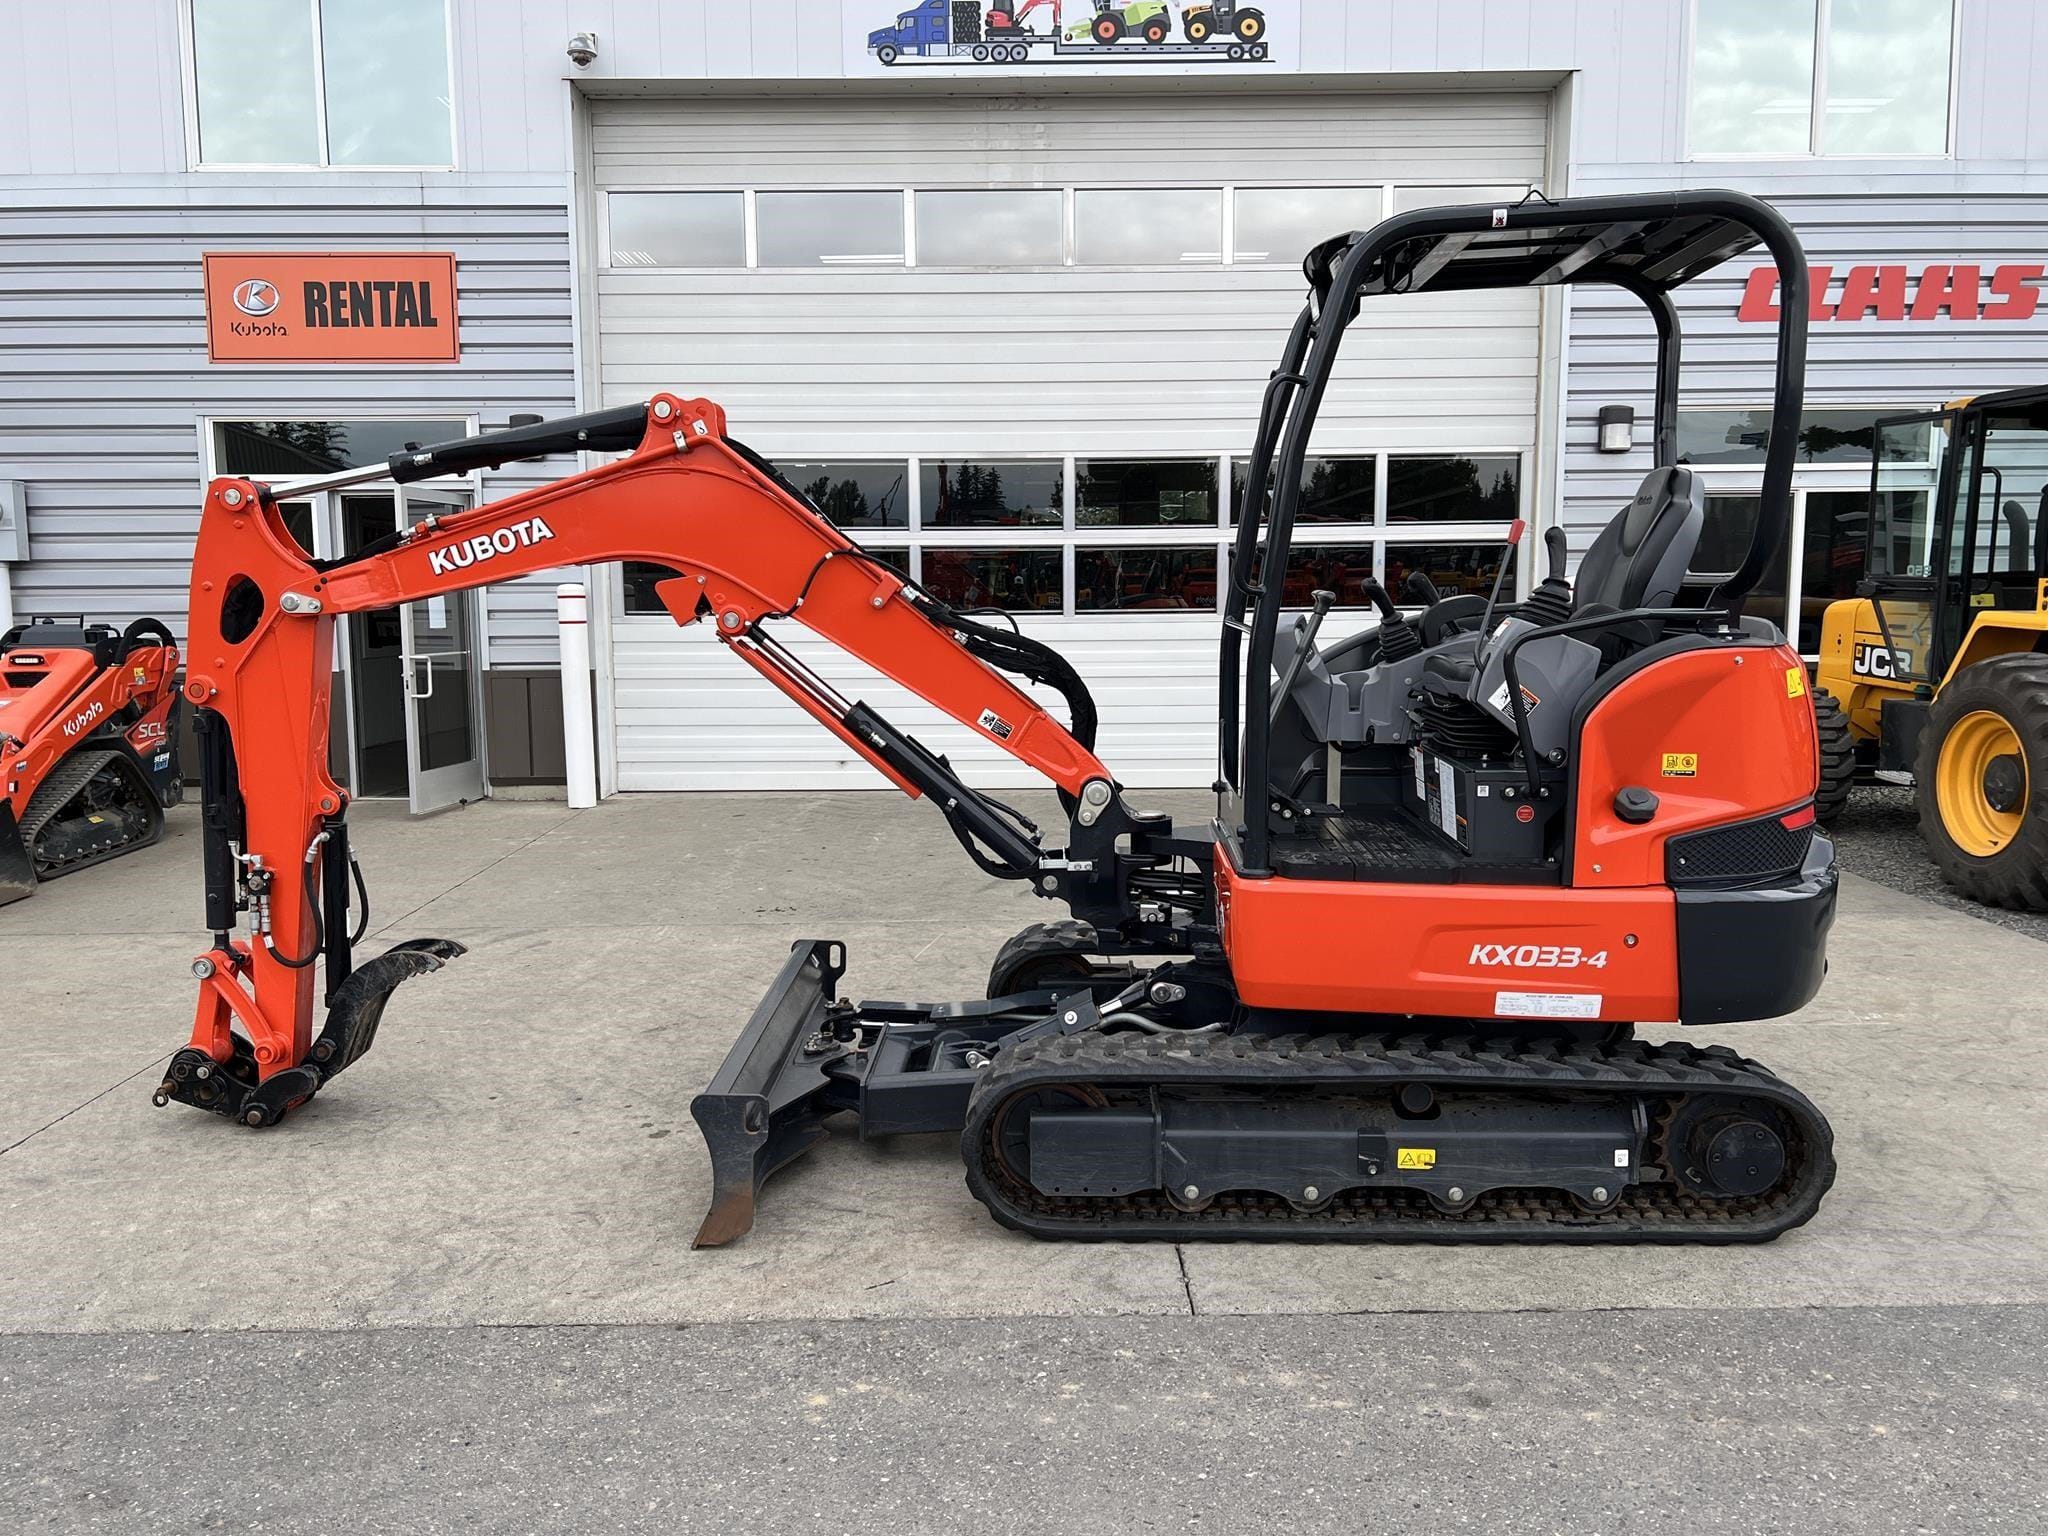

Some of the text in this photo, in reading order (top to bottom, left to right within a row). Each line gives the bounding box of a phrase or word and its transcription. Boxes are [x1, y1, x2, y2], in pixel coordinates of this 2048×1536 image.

[303, 281, 438, 328] RENTAL
[1737, 265, 2046, 322] CLAAS
[230, 322, 288, 337] Kubota
[428, 516, 555, 576] KUBOTA
[1854, 646, 1912, 678] JCB
[63, 702, 104, 736] Kubota
[138, 722, 165, 738] SCL
[1468, 944, 1608, 969] KX033-4
